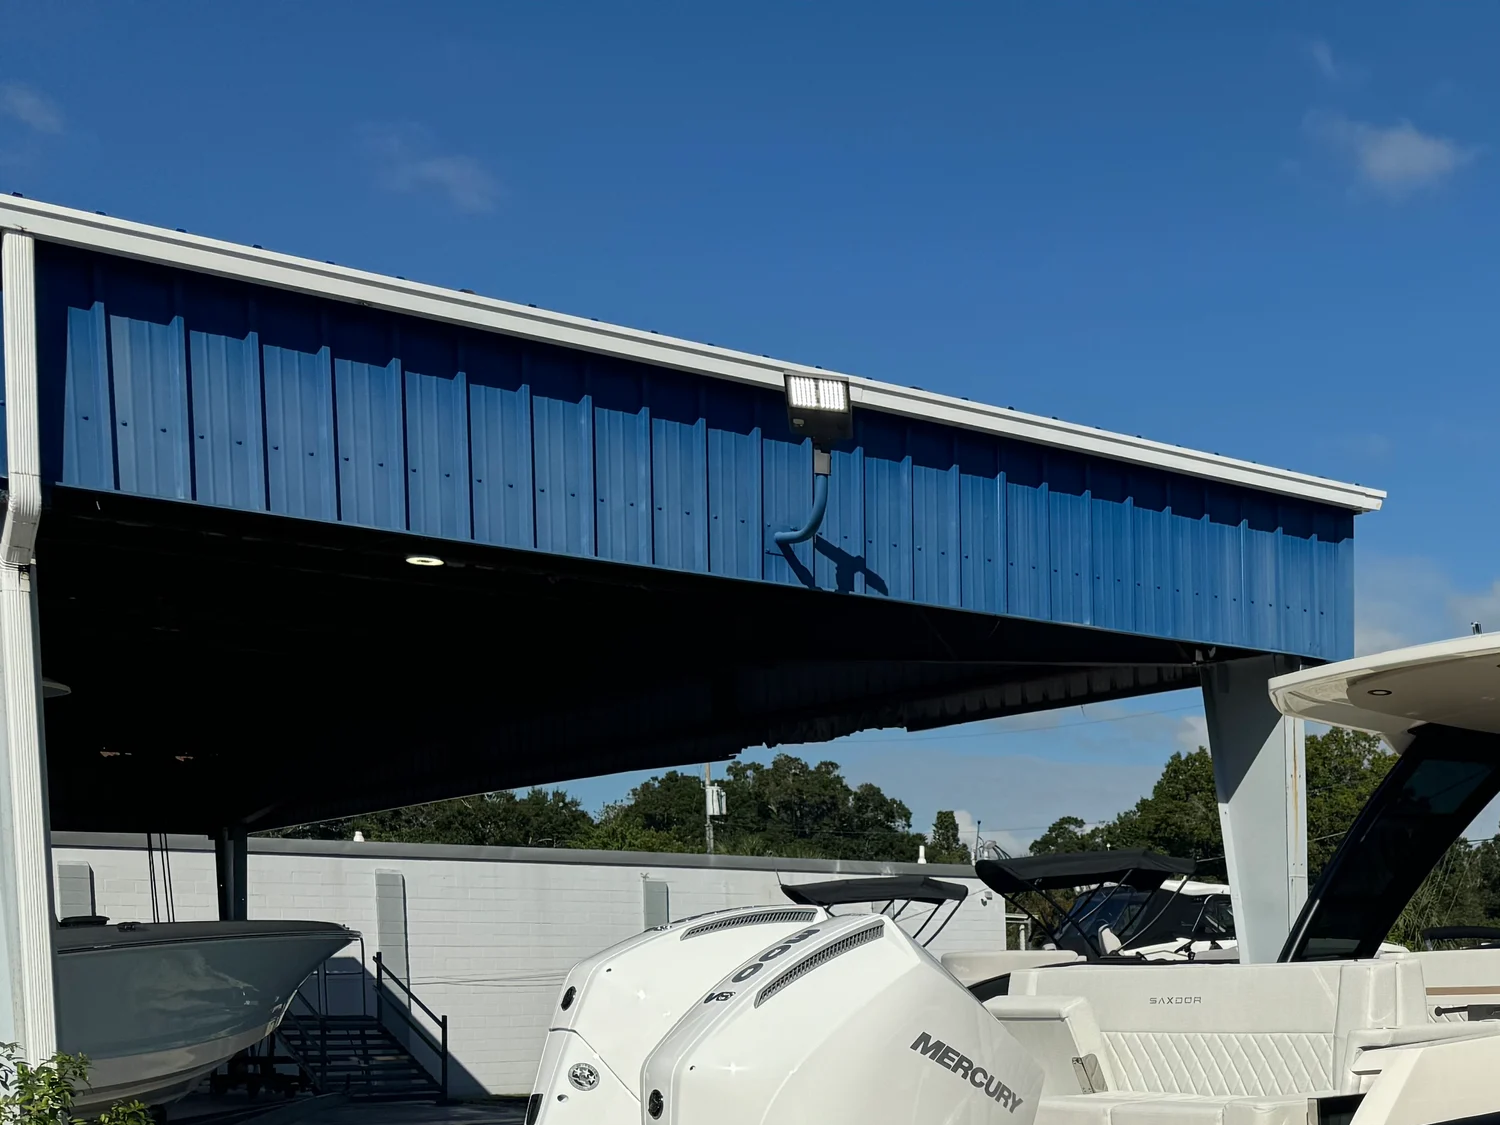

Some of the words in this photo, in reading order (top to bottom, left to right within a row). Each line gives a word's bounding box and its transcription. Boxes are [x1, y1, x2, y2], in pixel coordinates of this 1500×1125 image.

[731, 928, 820, 983] 300
[1149, 996, 1202, 1005] SAXDOR
[909, 1031, 1024, 1114] MERCURY
